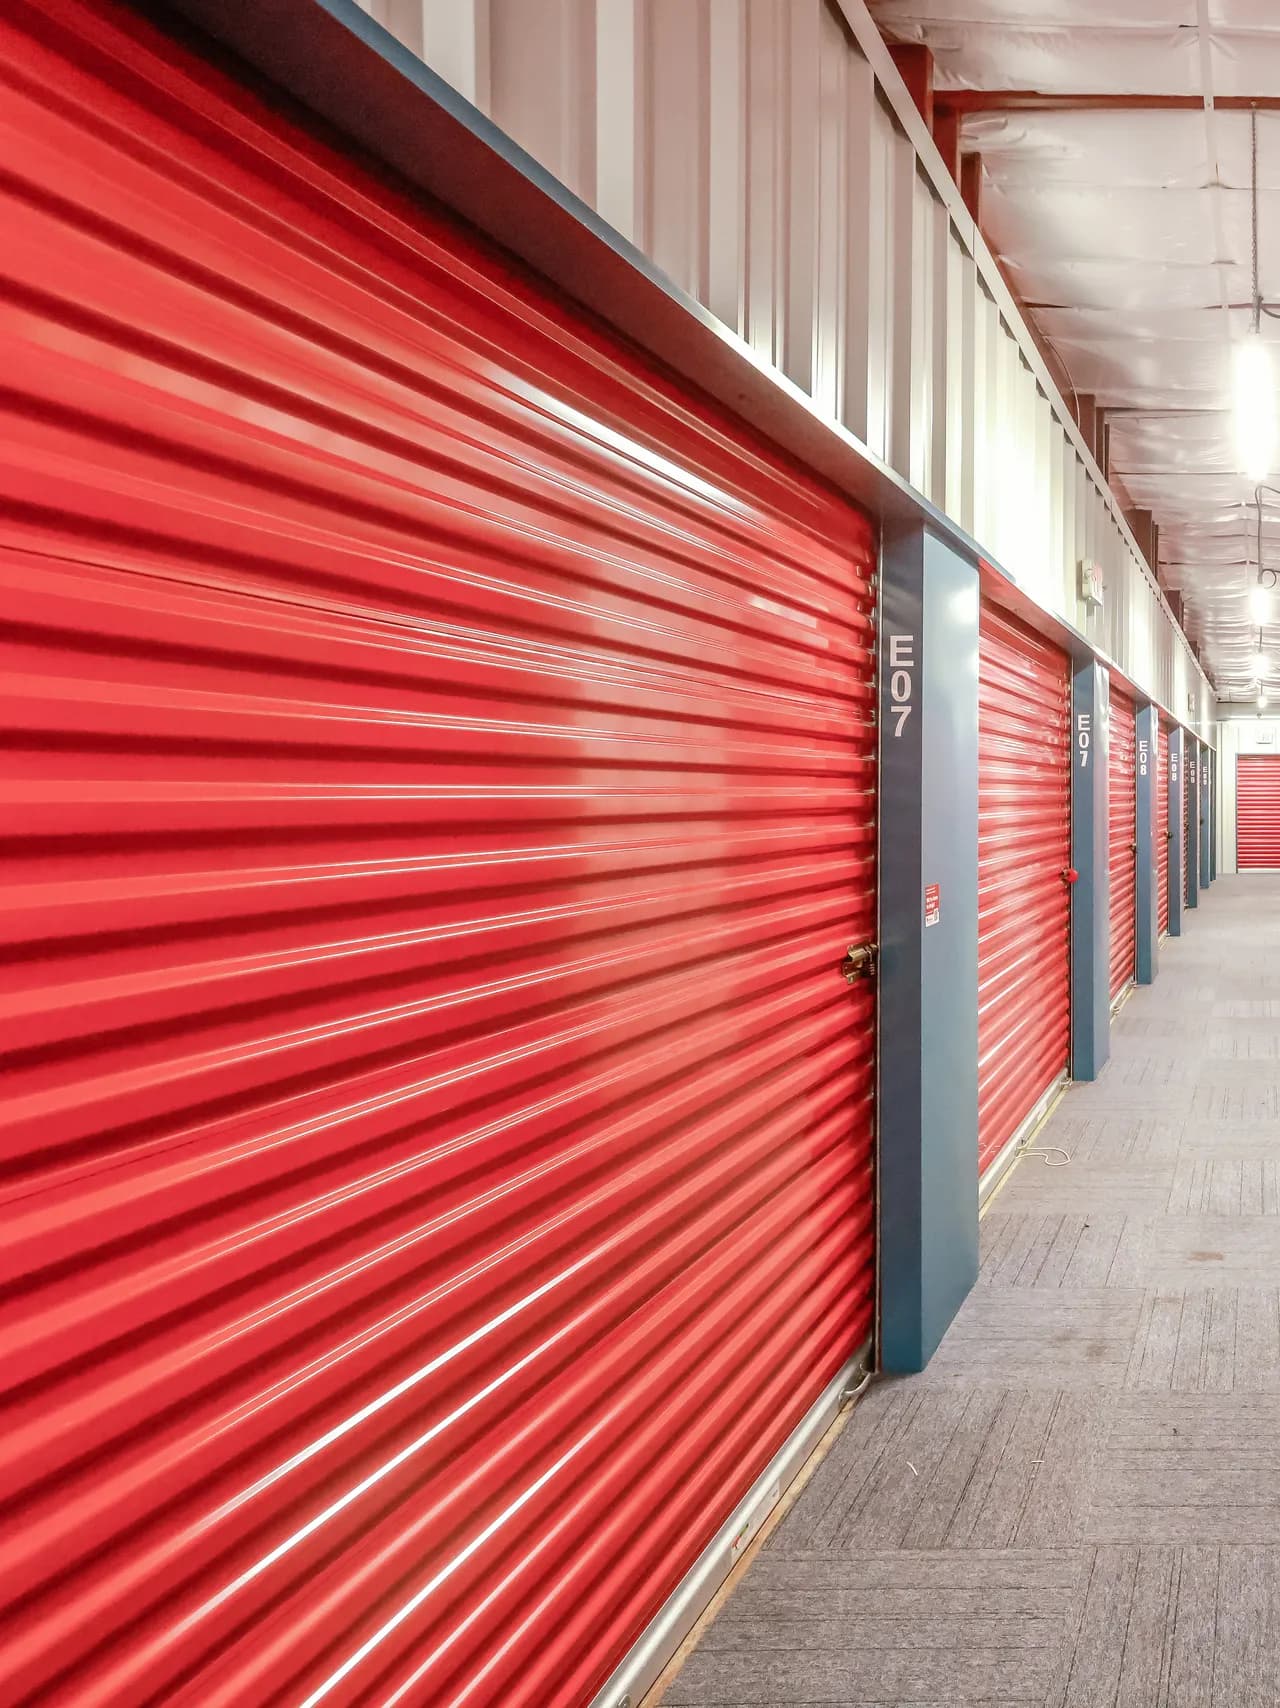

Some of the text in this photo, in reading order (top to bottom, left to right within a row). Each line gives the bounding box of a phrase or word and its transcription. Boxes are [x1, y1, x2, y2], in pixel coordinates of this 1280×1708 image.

[890, 635, 914, 737] E07
[1078, 715, 1090, 767] E07
[1140, 741, 1148, 775] E08
